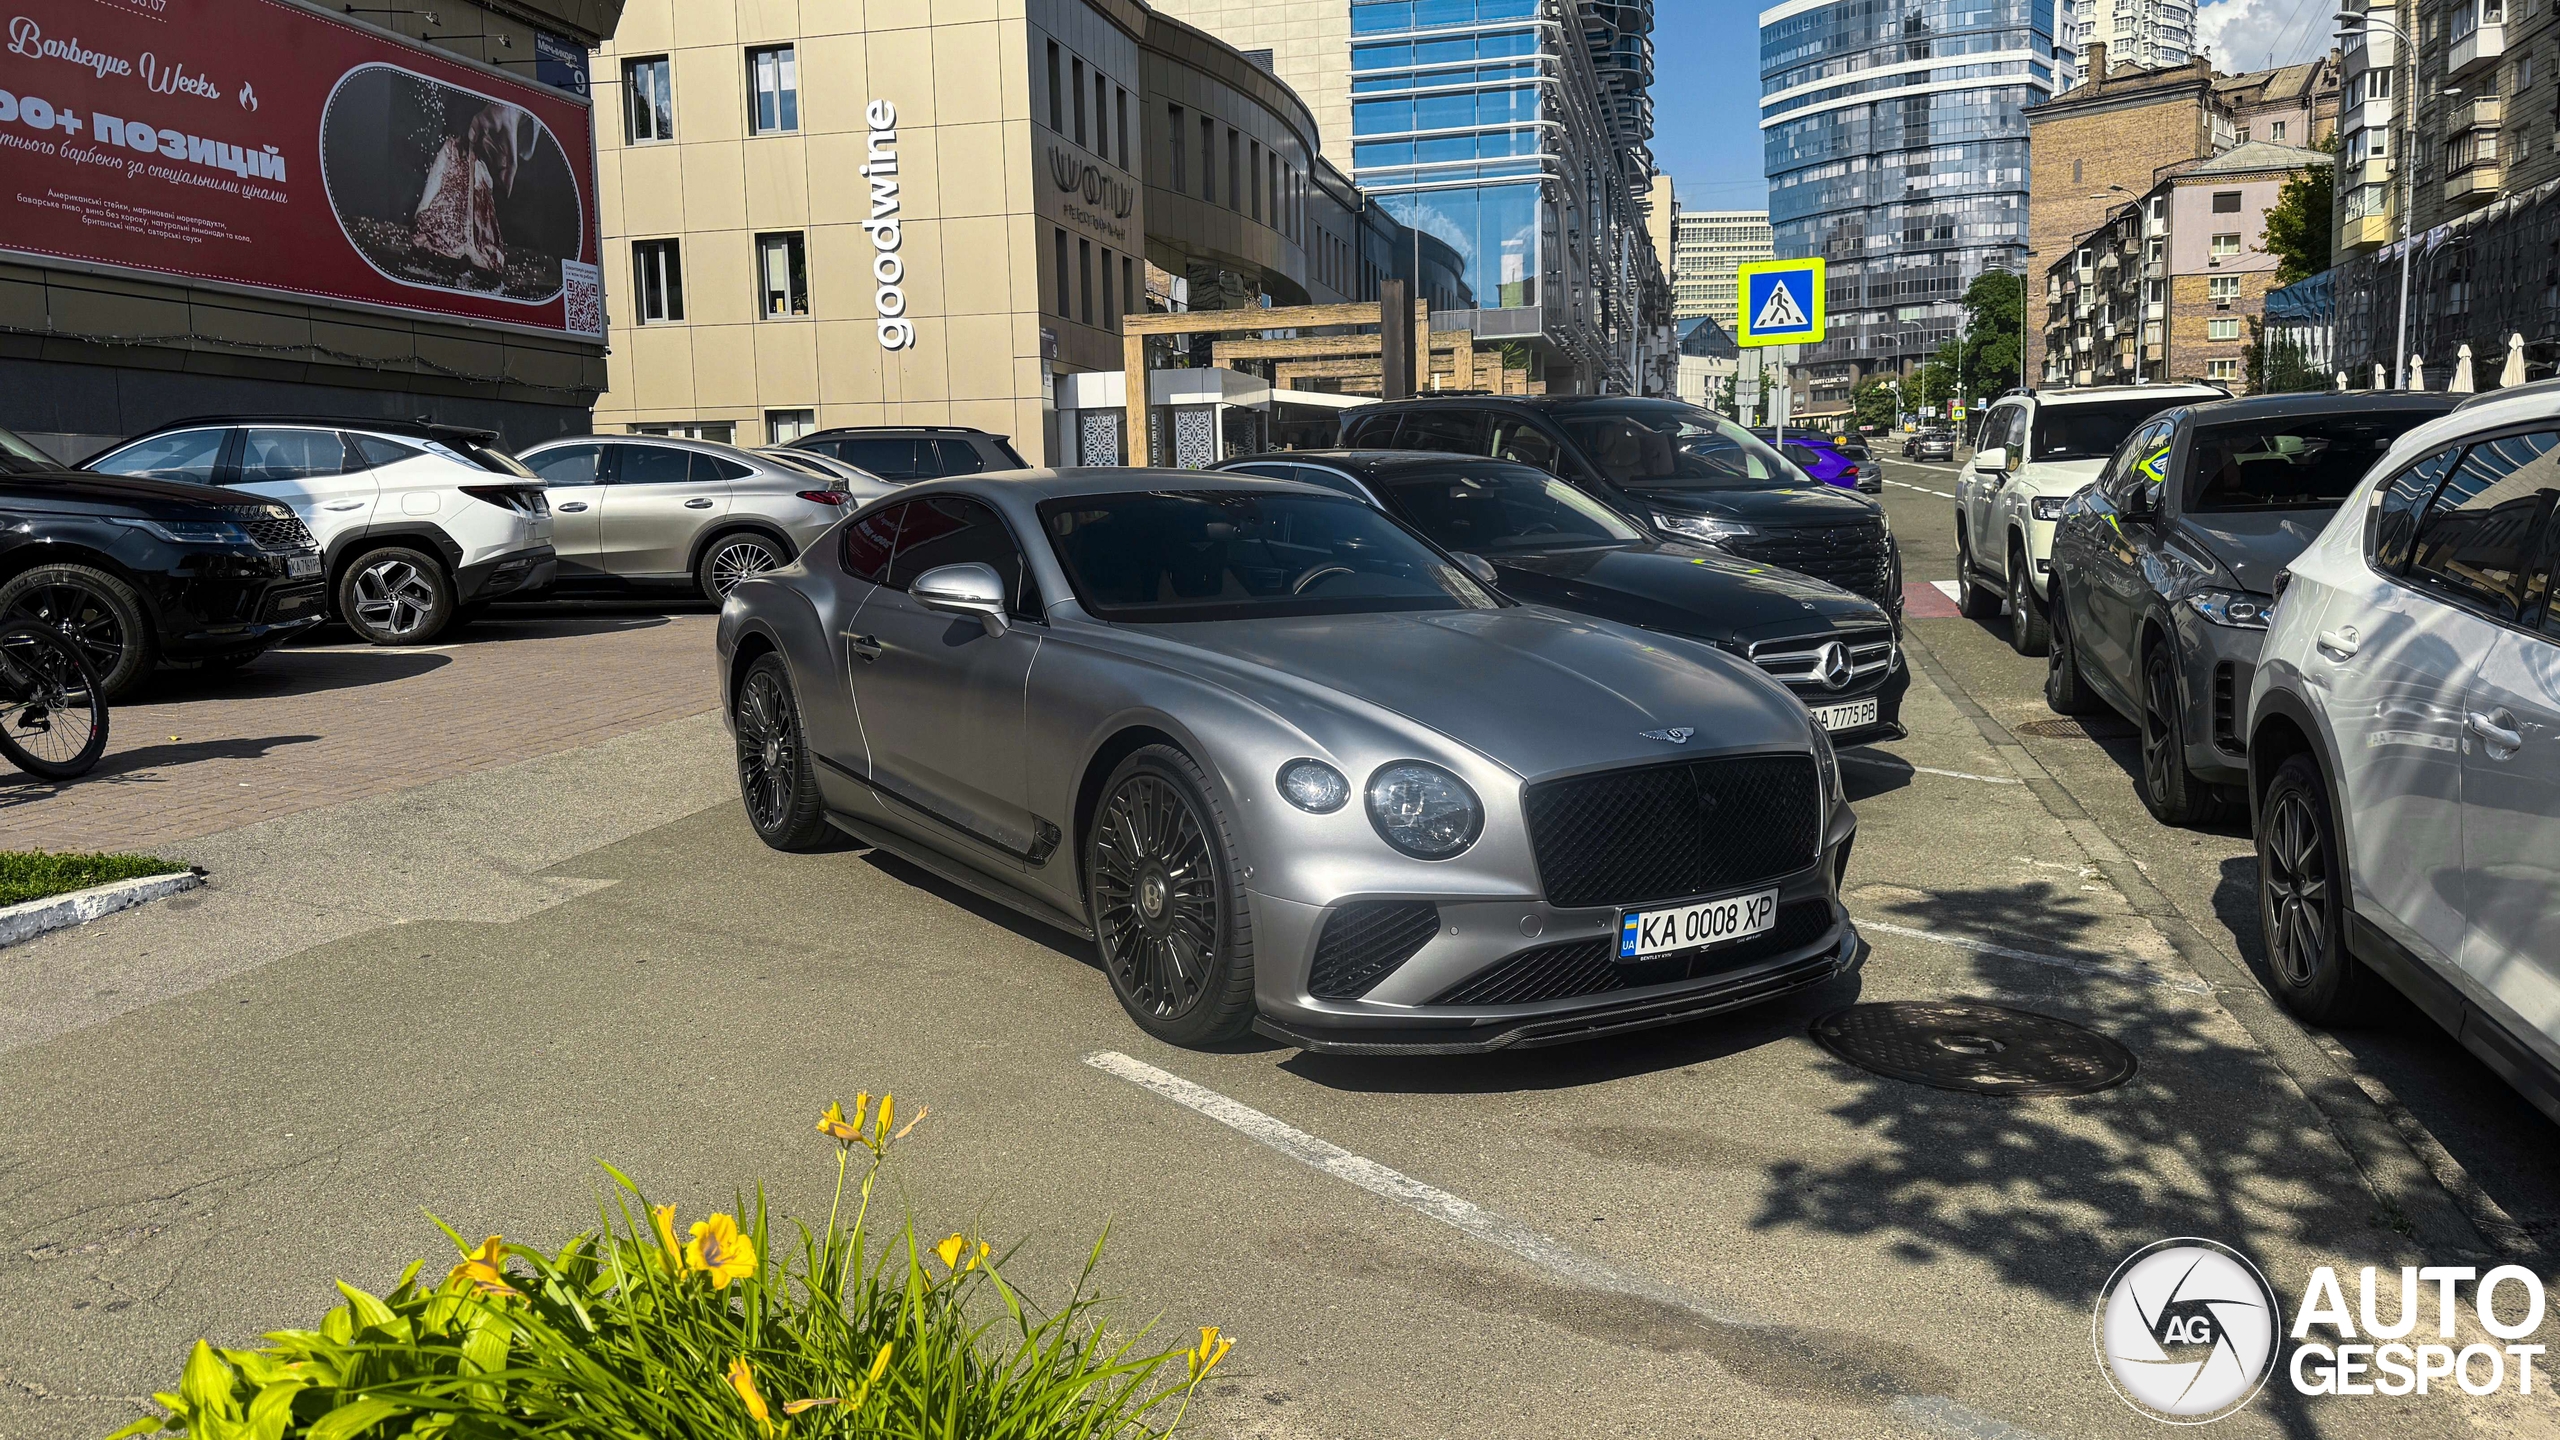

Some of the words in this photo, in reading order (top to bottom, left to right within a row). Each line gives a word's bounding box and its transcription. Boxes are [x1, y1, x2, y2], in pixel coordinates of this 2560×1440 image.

[130, 0, 167, 12] .07
[7, 16, 132, 79] Barbeque
[139, 52, 220, 99] Weeks
[573, 70, 586, 94] 9
[92, 111, 287, 182] ПОЗИЦІЙ
[0, 131, 55, 155] тнього
[60, 140, 123, 170] барбекю
[127, 159, 145, 178] за
[148, 164, 240, 194] спеціальними
[242, 183, 288, 204] цінами
[16, 192, 60, 208] баварське
[85, 207, 104, 217] вино
[47, 188, 102, 206] Американські
[859, 99, 916, 350] goodwine
[1813, 709, 1829, 729] A
[1832, 705, 1859, 728] 7775
[1860, 702, 1876, 723] PB
[1640, 914, 1677, 949] KA
[1685, 903, 1738, 942] 0008
[1742, 896, 1773, 932] XP
[1622, 940, 1635, 950] UA
[1640, 953, 1661, 962] BENTLEY
